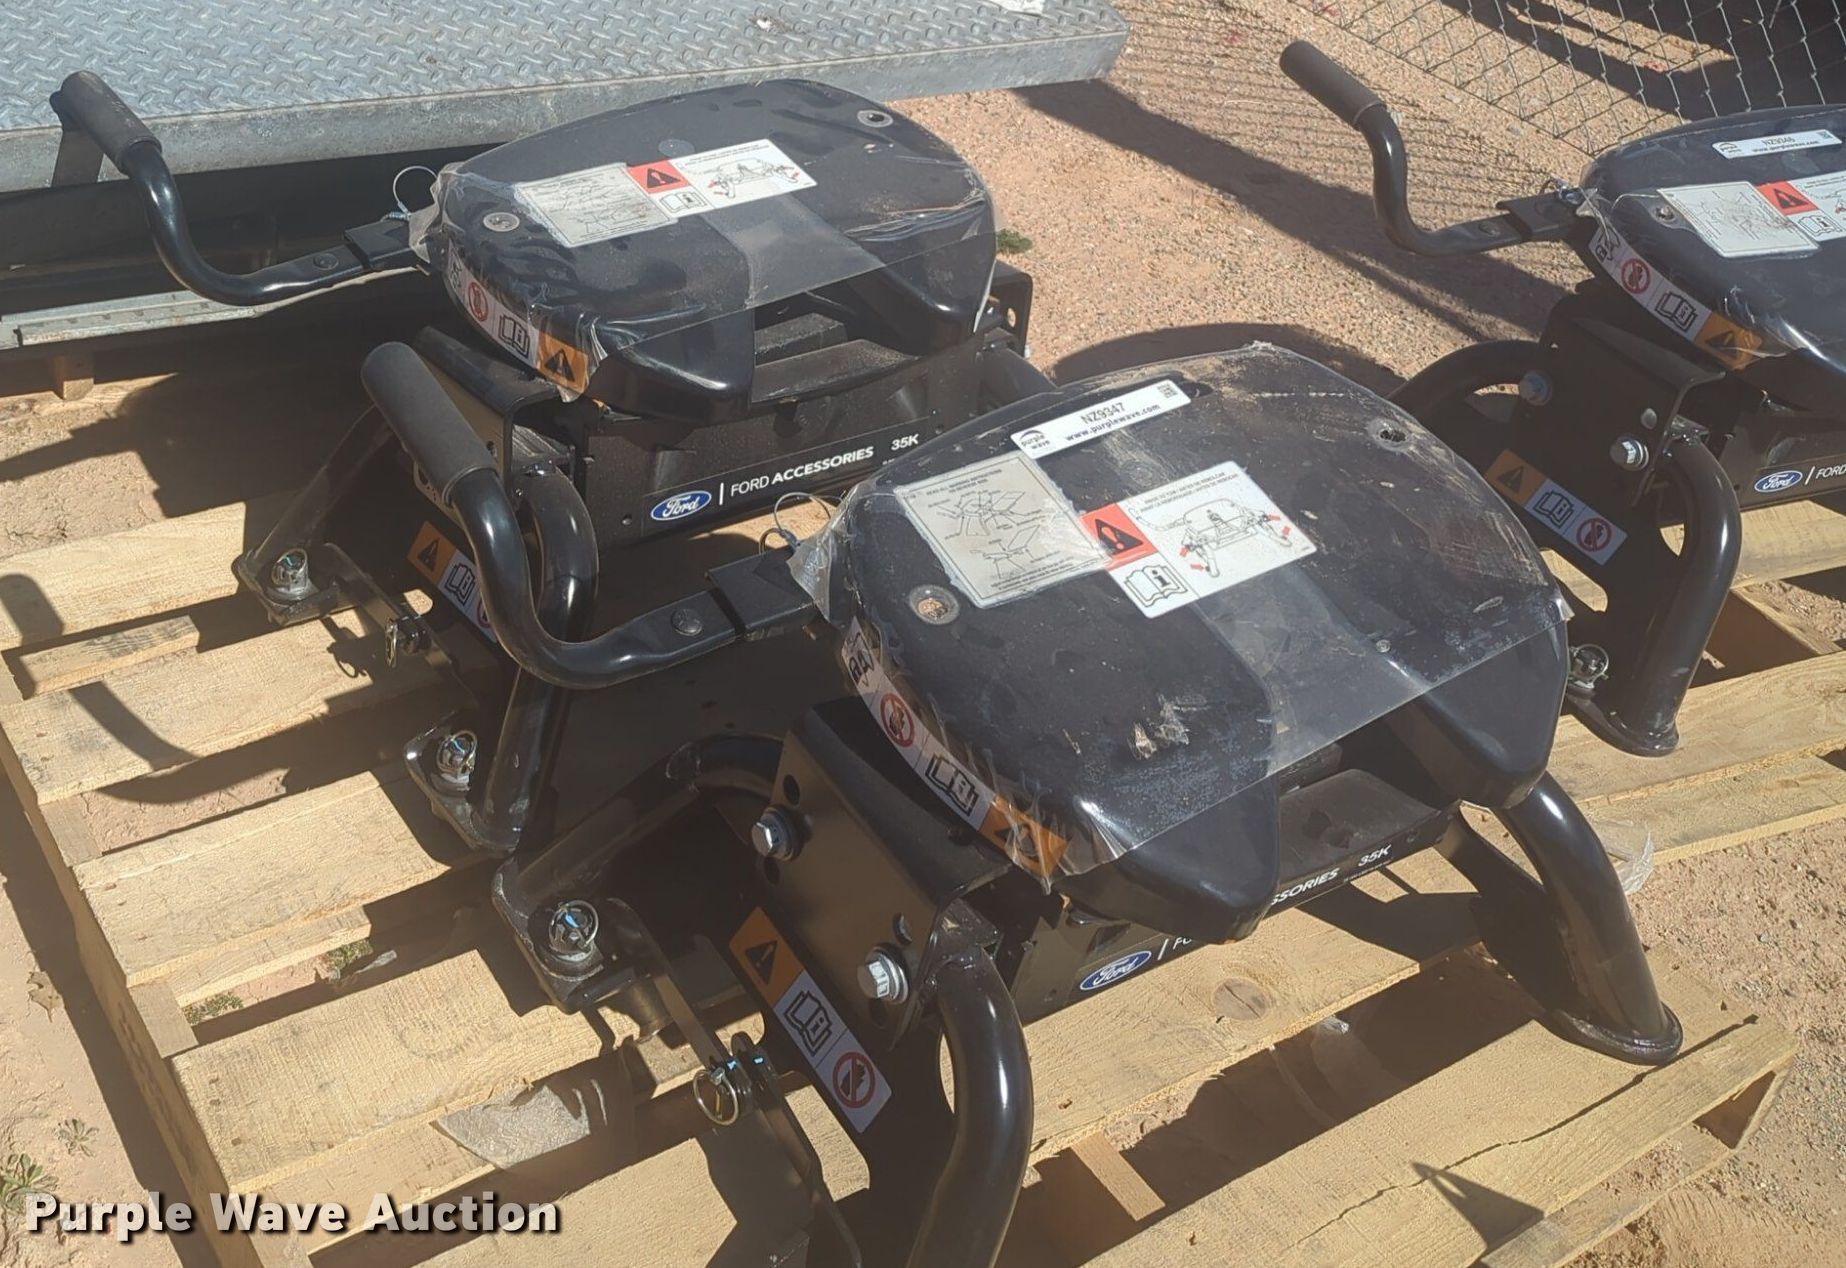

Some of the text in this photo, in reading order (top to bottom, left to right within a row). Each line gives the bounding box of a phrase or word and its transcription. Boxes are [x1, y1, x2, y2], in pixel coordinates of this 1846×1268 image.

[1065, 403, 1160, 441] www.purplewave.com
[1081, 402, 1125, 424] NZ9347
[1021, 433, 1045, 447] purple
[1031, 440, 1050, 450] wave
[660, 433, 920, 518] Ford FORD ACCESSORIES 35K
[1358, 845, 1393, 867] 35K
